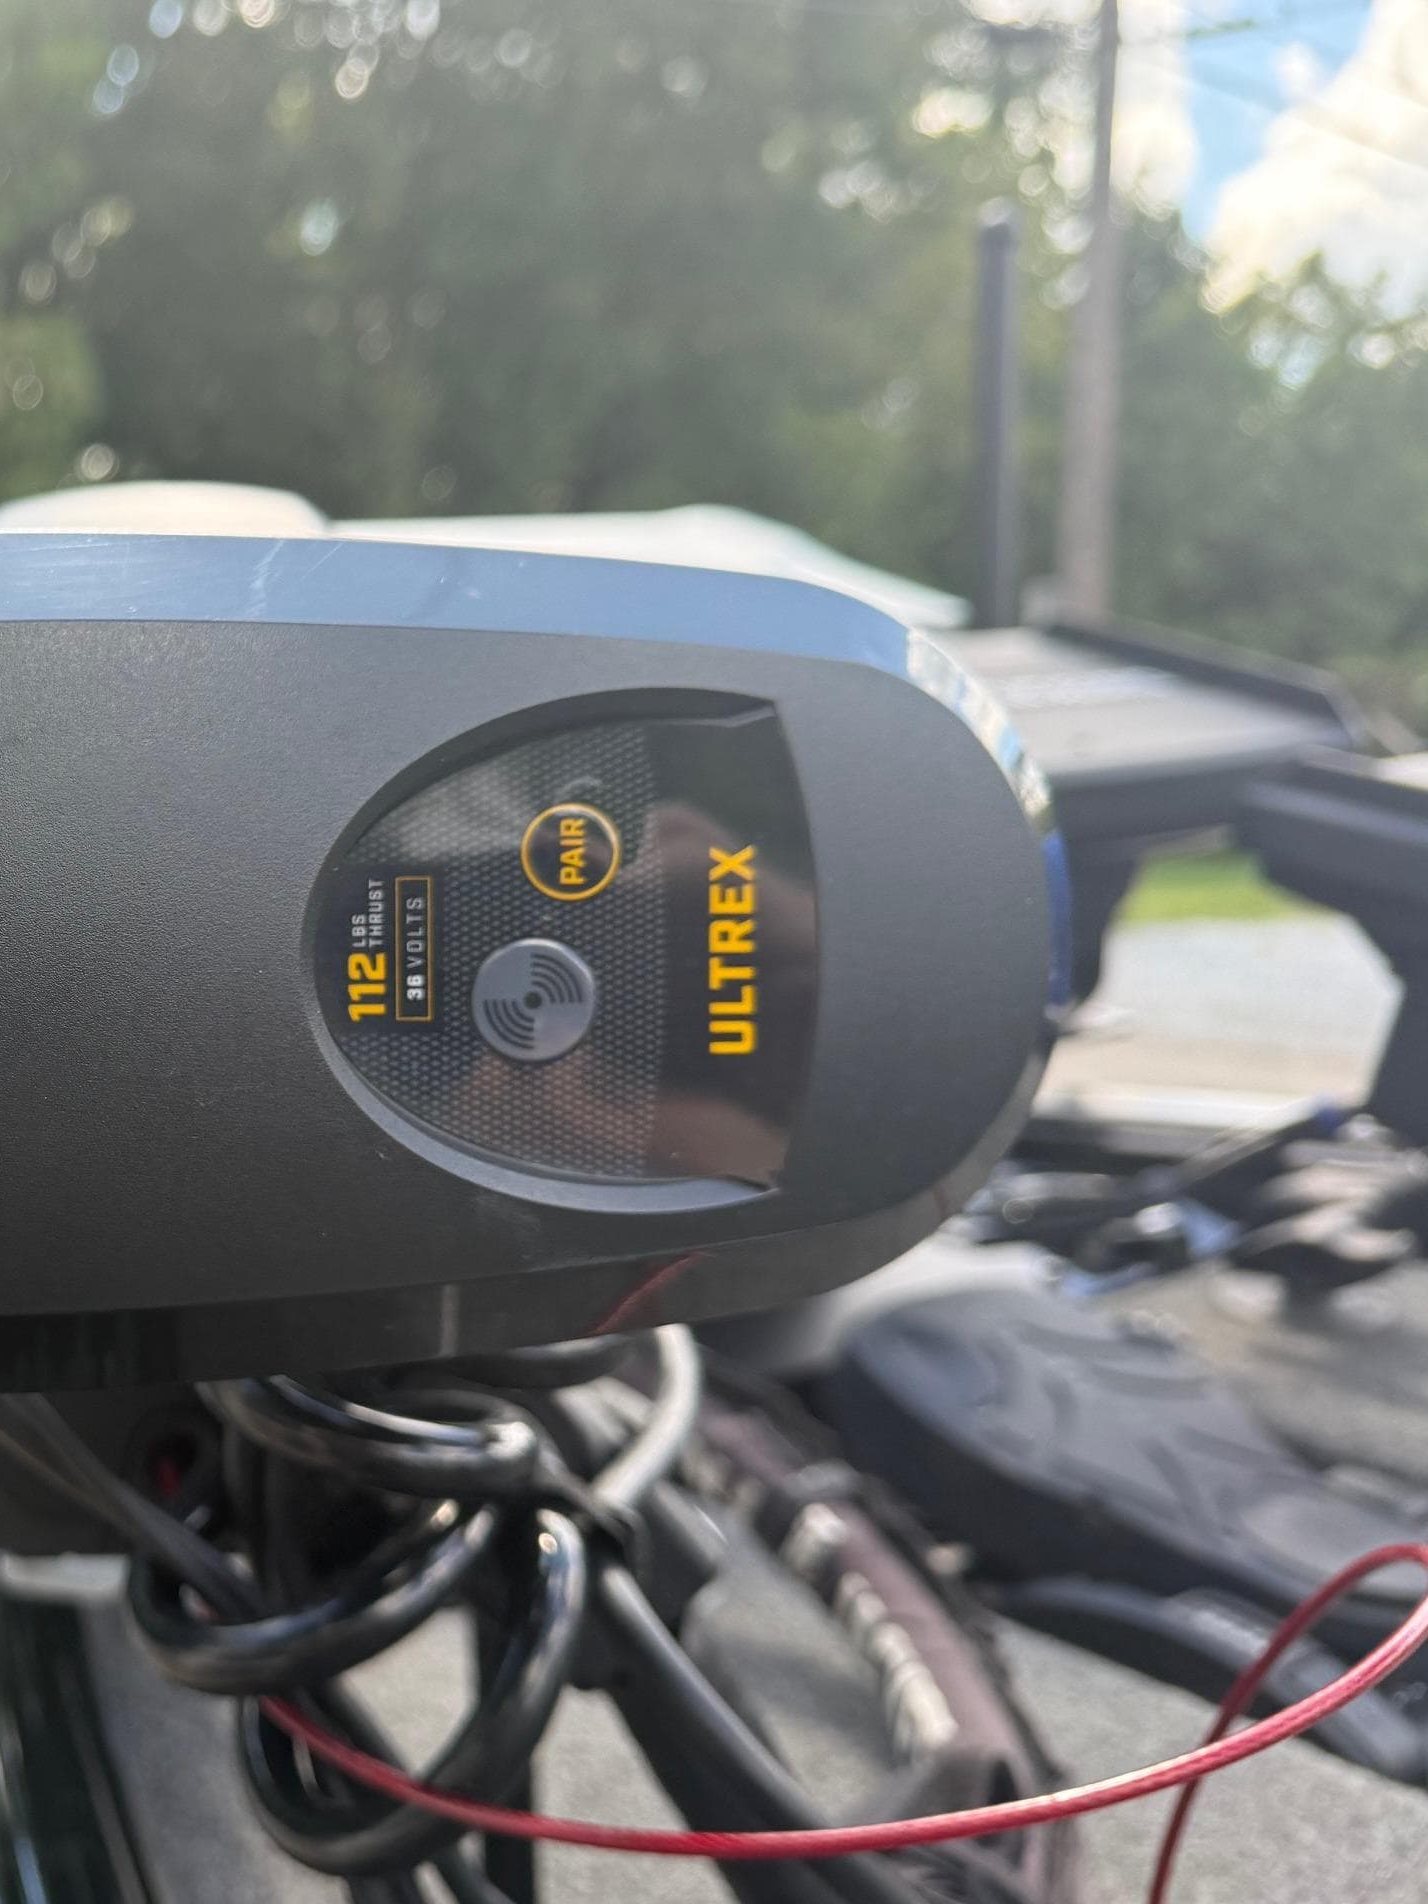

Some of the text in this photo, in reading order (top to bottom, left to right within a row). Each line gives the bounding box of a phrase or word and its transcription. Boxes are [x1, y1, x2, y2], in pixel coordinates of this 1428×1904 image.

[559, 818, 587, 886] PAIR
[351, 913, 367, 949] LBS
[368, 879, 384, 949] THRUST
[406, 896, 425, 1001] 36 VOLTS
[708, 844, 756, 1056] ULTREX
[347, 953, 386, 1022] 112
